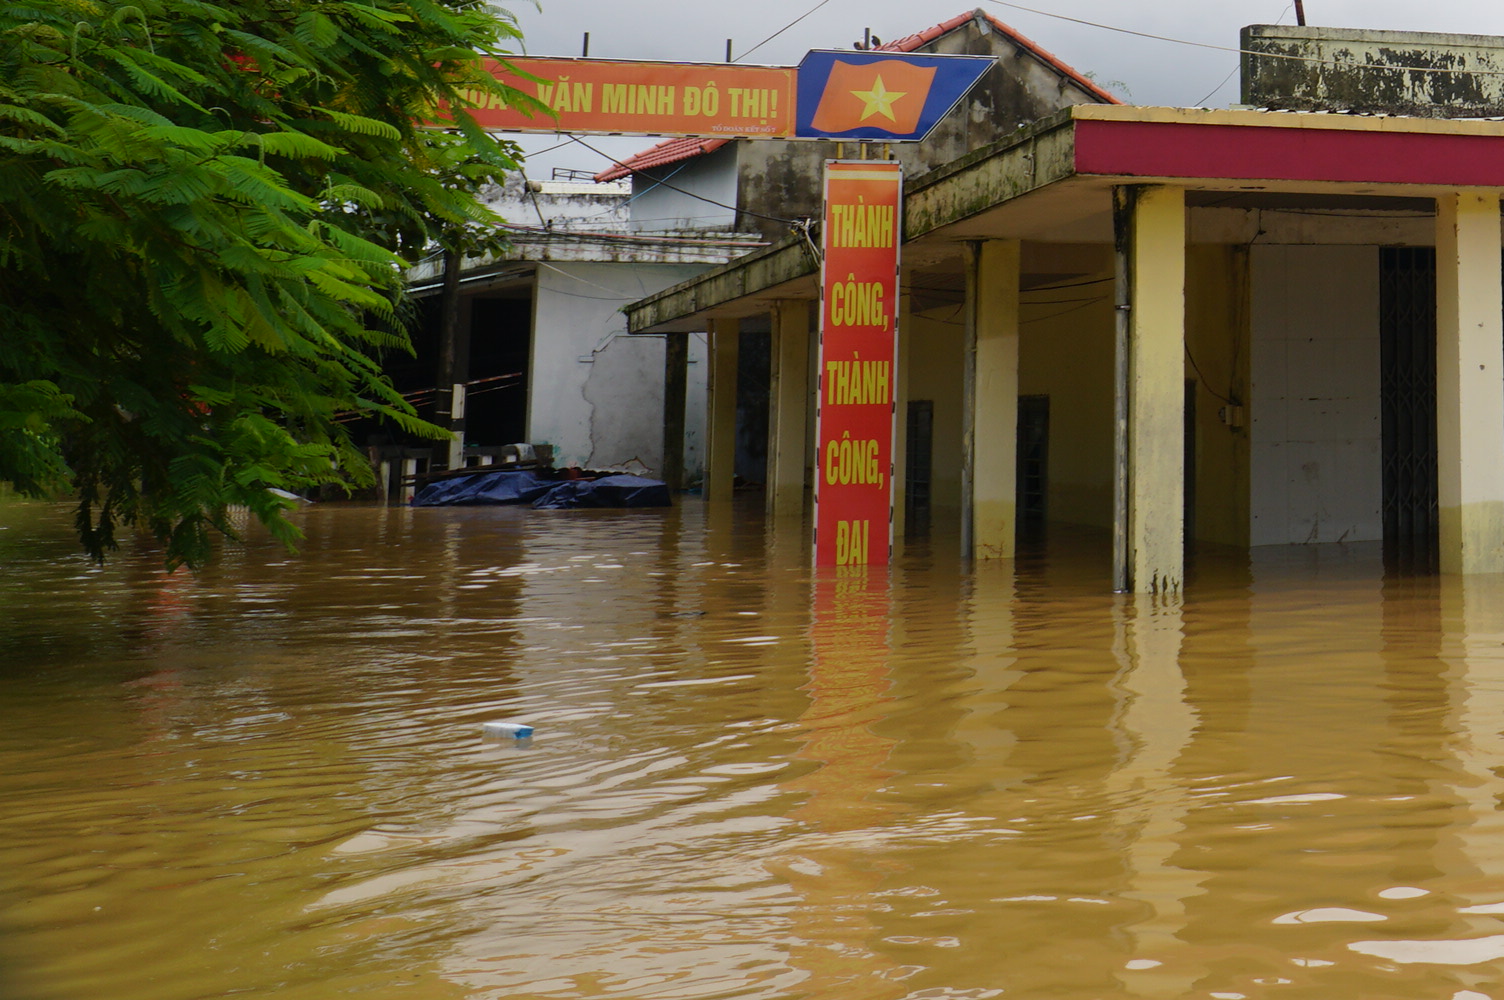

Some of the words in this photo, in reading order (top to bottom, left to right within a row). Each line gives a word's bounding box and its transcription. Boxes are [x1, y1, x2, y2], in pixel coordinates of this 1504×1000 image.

[537, 75, 593, 112] VĂN
[602, 83, 675, 115] MINH
[683, 81, 719, 116] ĐÔ
[728, 88, 778, 125] THỊ!
[832, 195, 893, 248] THÀNH
[831, 273, 888, 332] CÔNG,
[827, 351, 889, 405] THÀNH
[826, 430, 884, 490] CÔNG,
